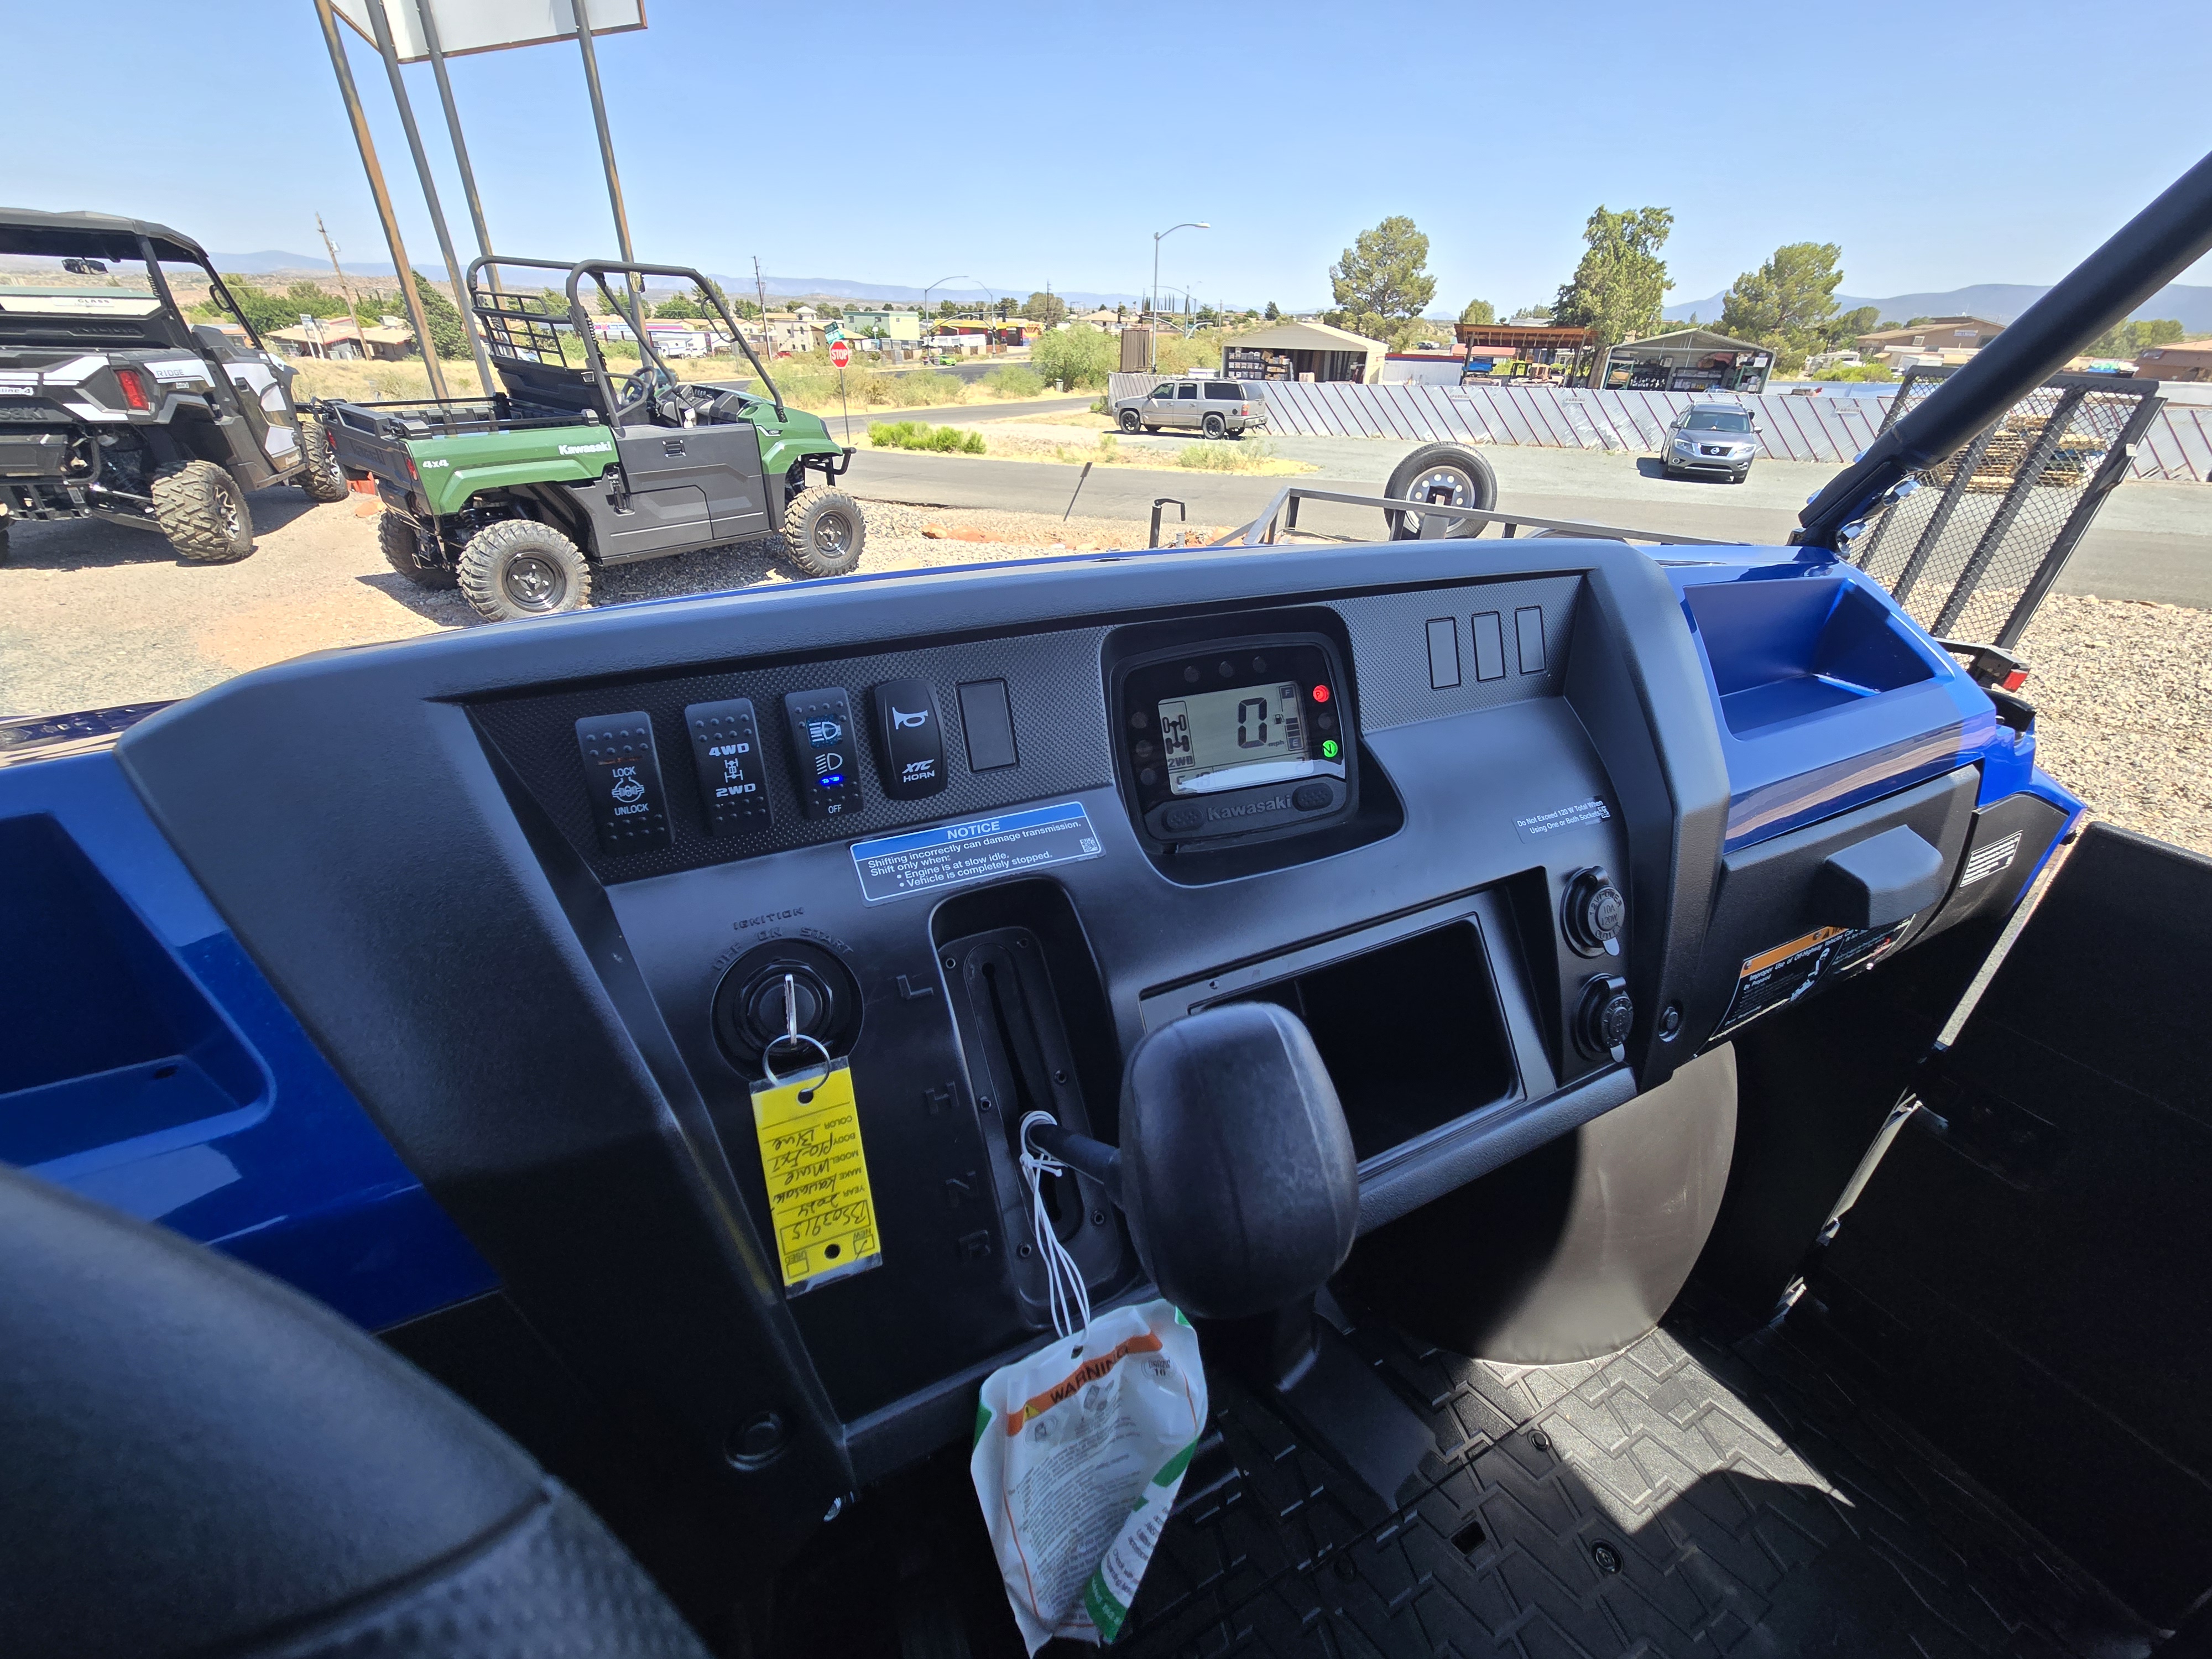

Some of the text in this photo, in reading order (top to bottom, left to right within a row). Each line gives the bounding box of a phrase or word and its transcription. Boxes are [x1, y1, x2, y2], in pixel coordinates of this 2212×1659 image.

[831, 349, 848, 361] STOP
[558, 441, 613, 455] Kawasaki
[422, 459, 450, 468] 4x4
[1238, 697, 1267, 749] 0
[709, 743, 750, 757] 4WD
[901, 759, 935, 774] XTC
[1167, 755, 1193, 768] 2WD
[612, 766, 637, 778] LOCK
[902, 770, 935, 783] HORN
[716, 783, 756, 797] 2WD
[614, 803, 649, 816] UNLOCK
[828, 804, 842, 814] OFF
[1206, 795, 1292, 821] Kawasaki
[1526, 816, 1537, 825] Not
[1537, 811, 1558, 822] Exceed
[1574, 804, 1588, 812] Total
[1587, 800, 1604, 808] When
[1530, 825, 1548, 834] Using
[1565, 816, 1580, 825] Both
[1579, 810, 1601, 821] Sockets
[947, 821, 1000, 839] NOTICE
[868, 821, 1082, 868] Shifting incorrectly can damage transmission.
[870, 855, 951, 877] Shift only when:
[904, 866, 940, 879] Engine
[953, 861, 963, 869] at
[964, 855, 987, 867] slow
[988, 852, 1010, 862] idle.
[906, 851, 1053, 887] Vehicle is completely stopped.
[1603, 904, 1615, 914] 10A
[733, 906, 805, 931] IGNITION
[1601, 914, 1618, 926] 120W
[757, 927, 782, 941] ON
[800, 926, 854, 954] START
[1749, 967, 1773, 981] Improper
[1775, 962, 1786, 970] Use
[1787, 956, 1794, 964] of
[925, 1081, 959, 1115] H
[824, 1115, 853, 1129] COLOR
[772, 1129, 815, 1151] Blue
[833, 1133, 855, 1145] BODY
[832, 1150, 859, 1164] MODEL
[838, 1166, 862, 1181] MAKE
[842, 1185, 865, 1197] YEAR
[797, 1193, 839, 1217] 2024
[853, 1227, 872, 1240] NEW
[785, 1250, 807, 1265] USED
